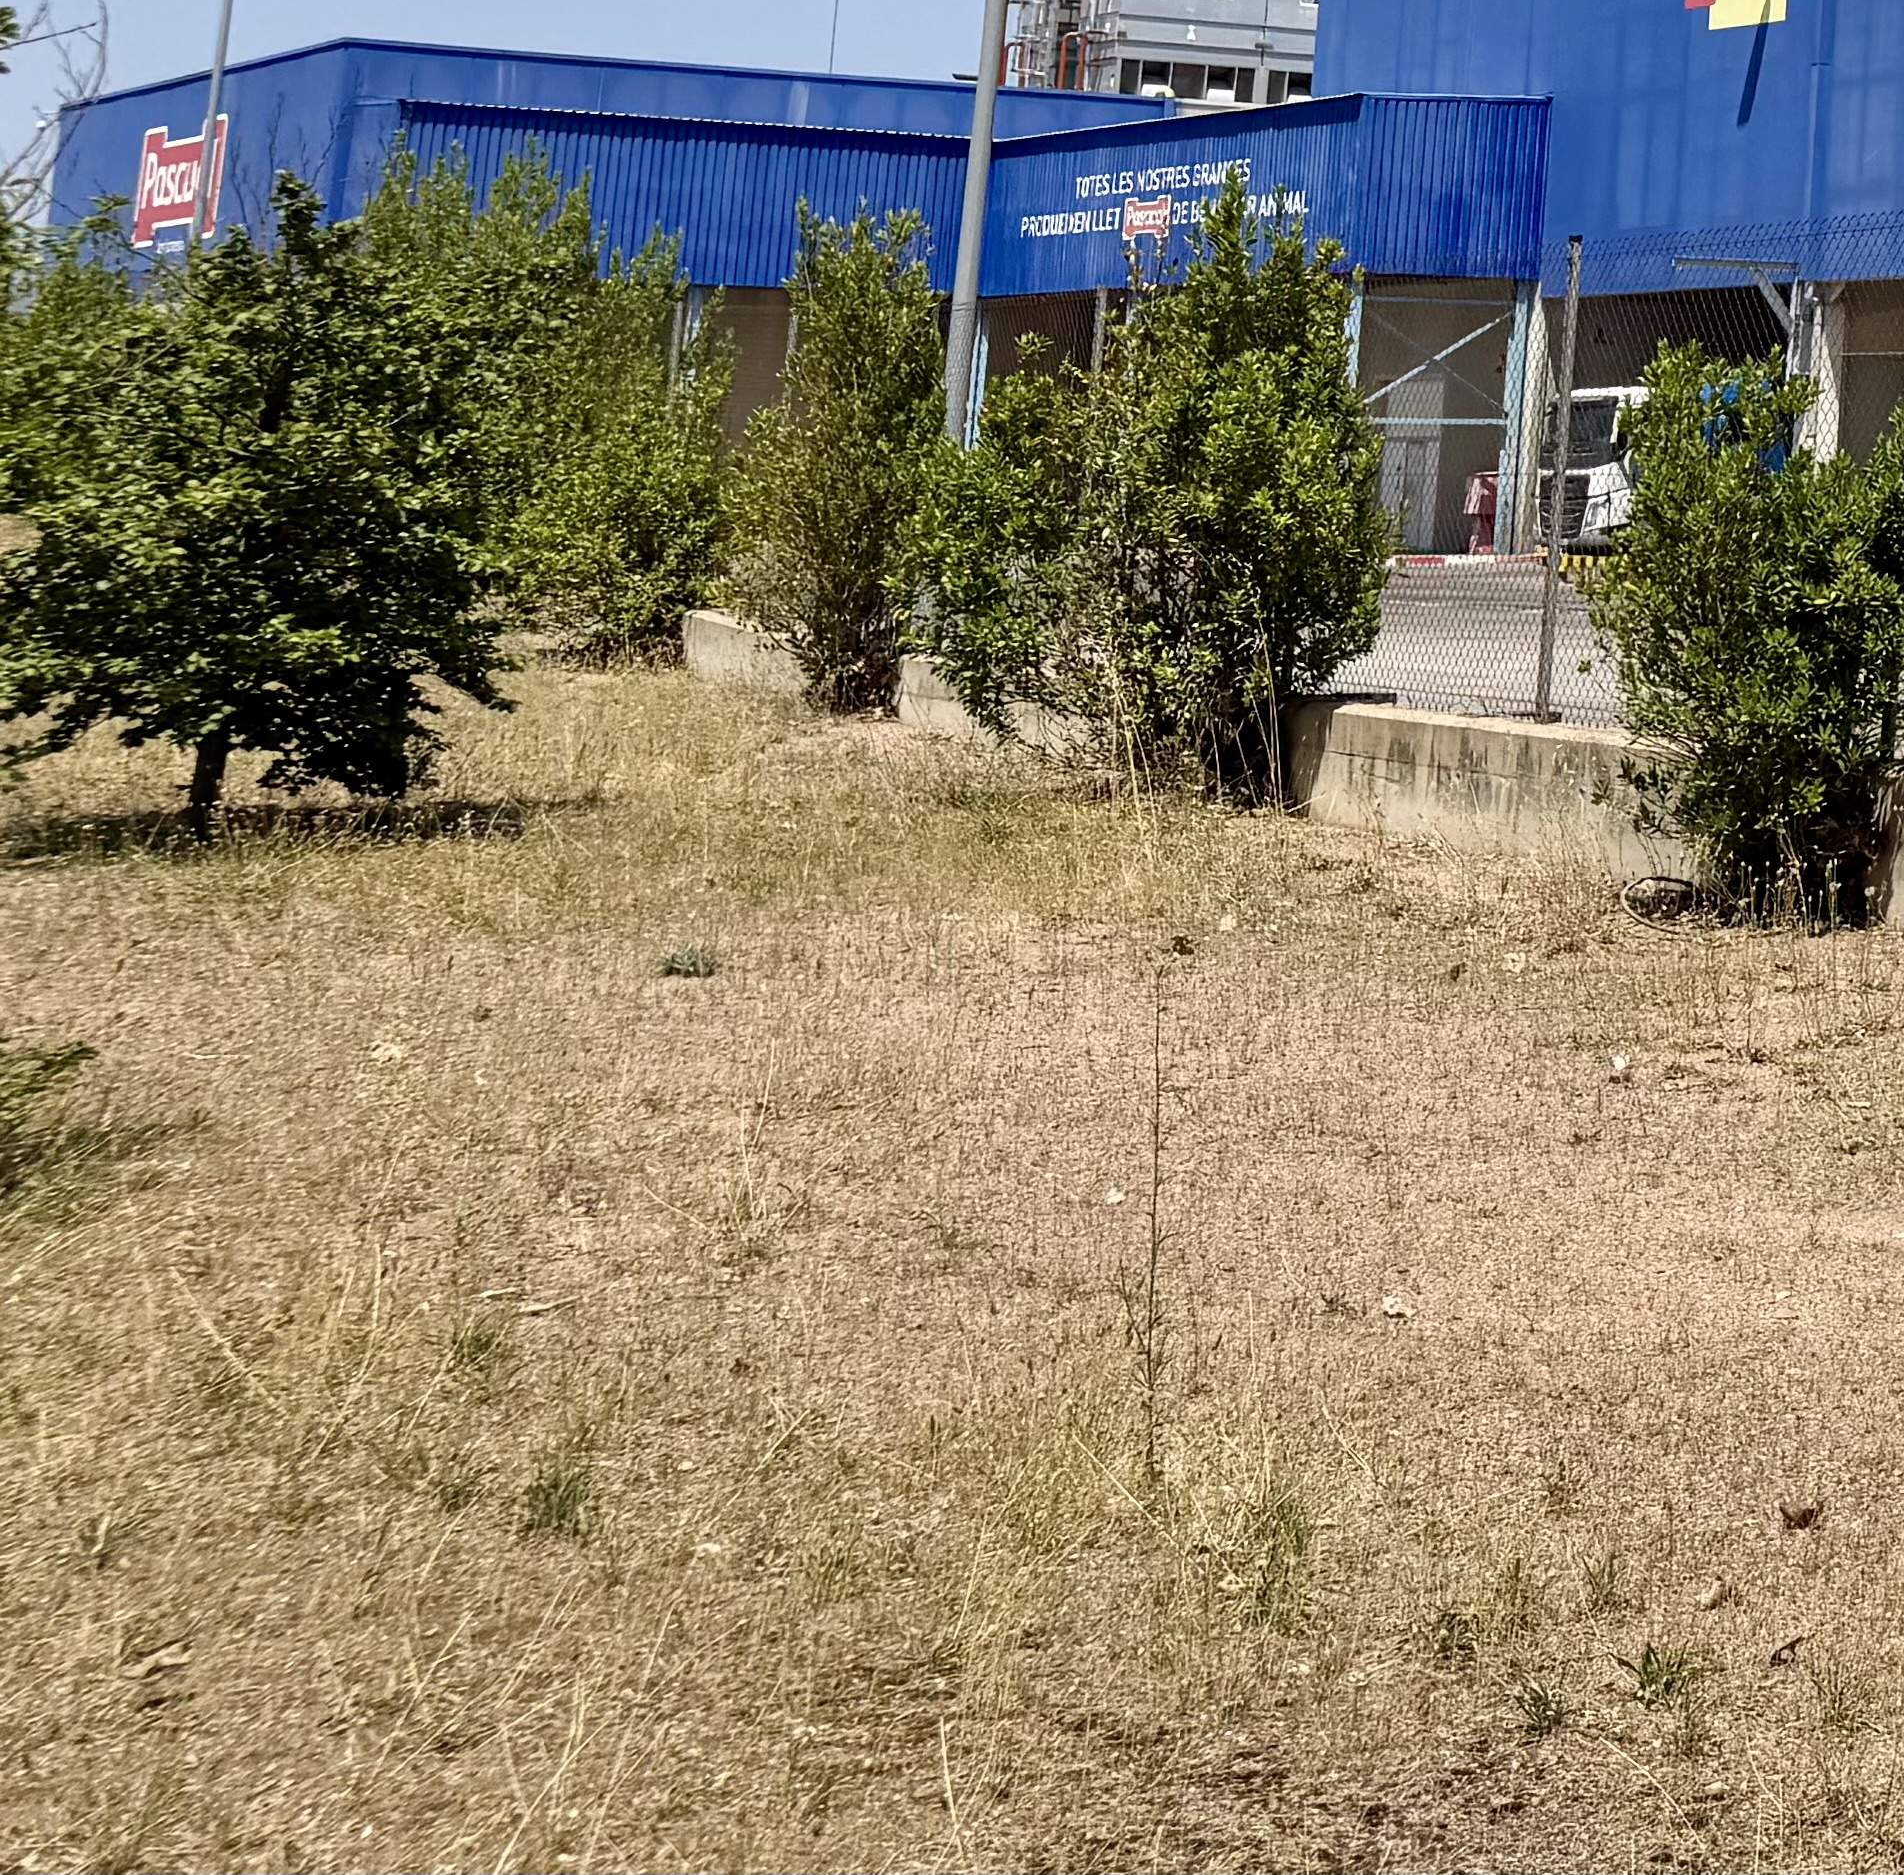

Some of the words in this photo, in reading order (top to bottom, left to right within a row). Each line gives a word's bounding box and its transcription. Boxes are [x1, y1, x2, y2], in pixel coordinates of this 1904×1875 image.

[1076, 173, 1110, 199] TOTES
[1112, 171, 1134, 194] LES
[1092, 207, 1121, 232] LLET
[1172, 201, 1189, 224] DE
[1258, 190, 1309, 217] ANMAL
